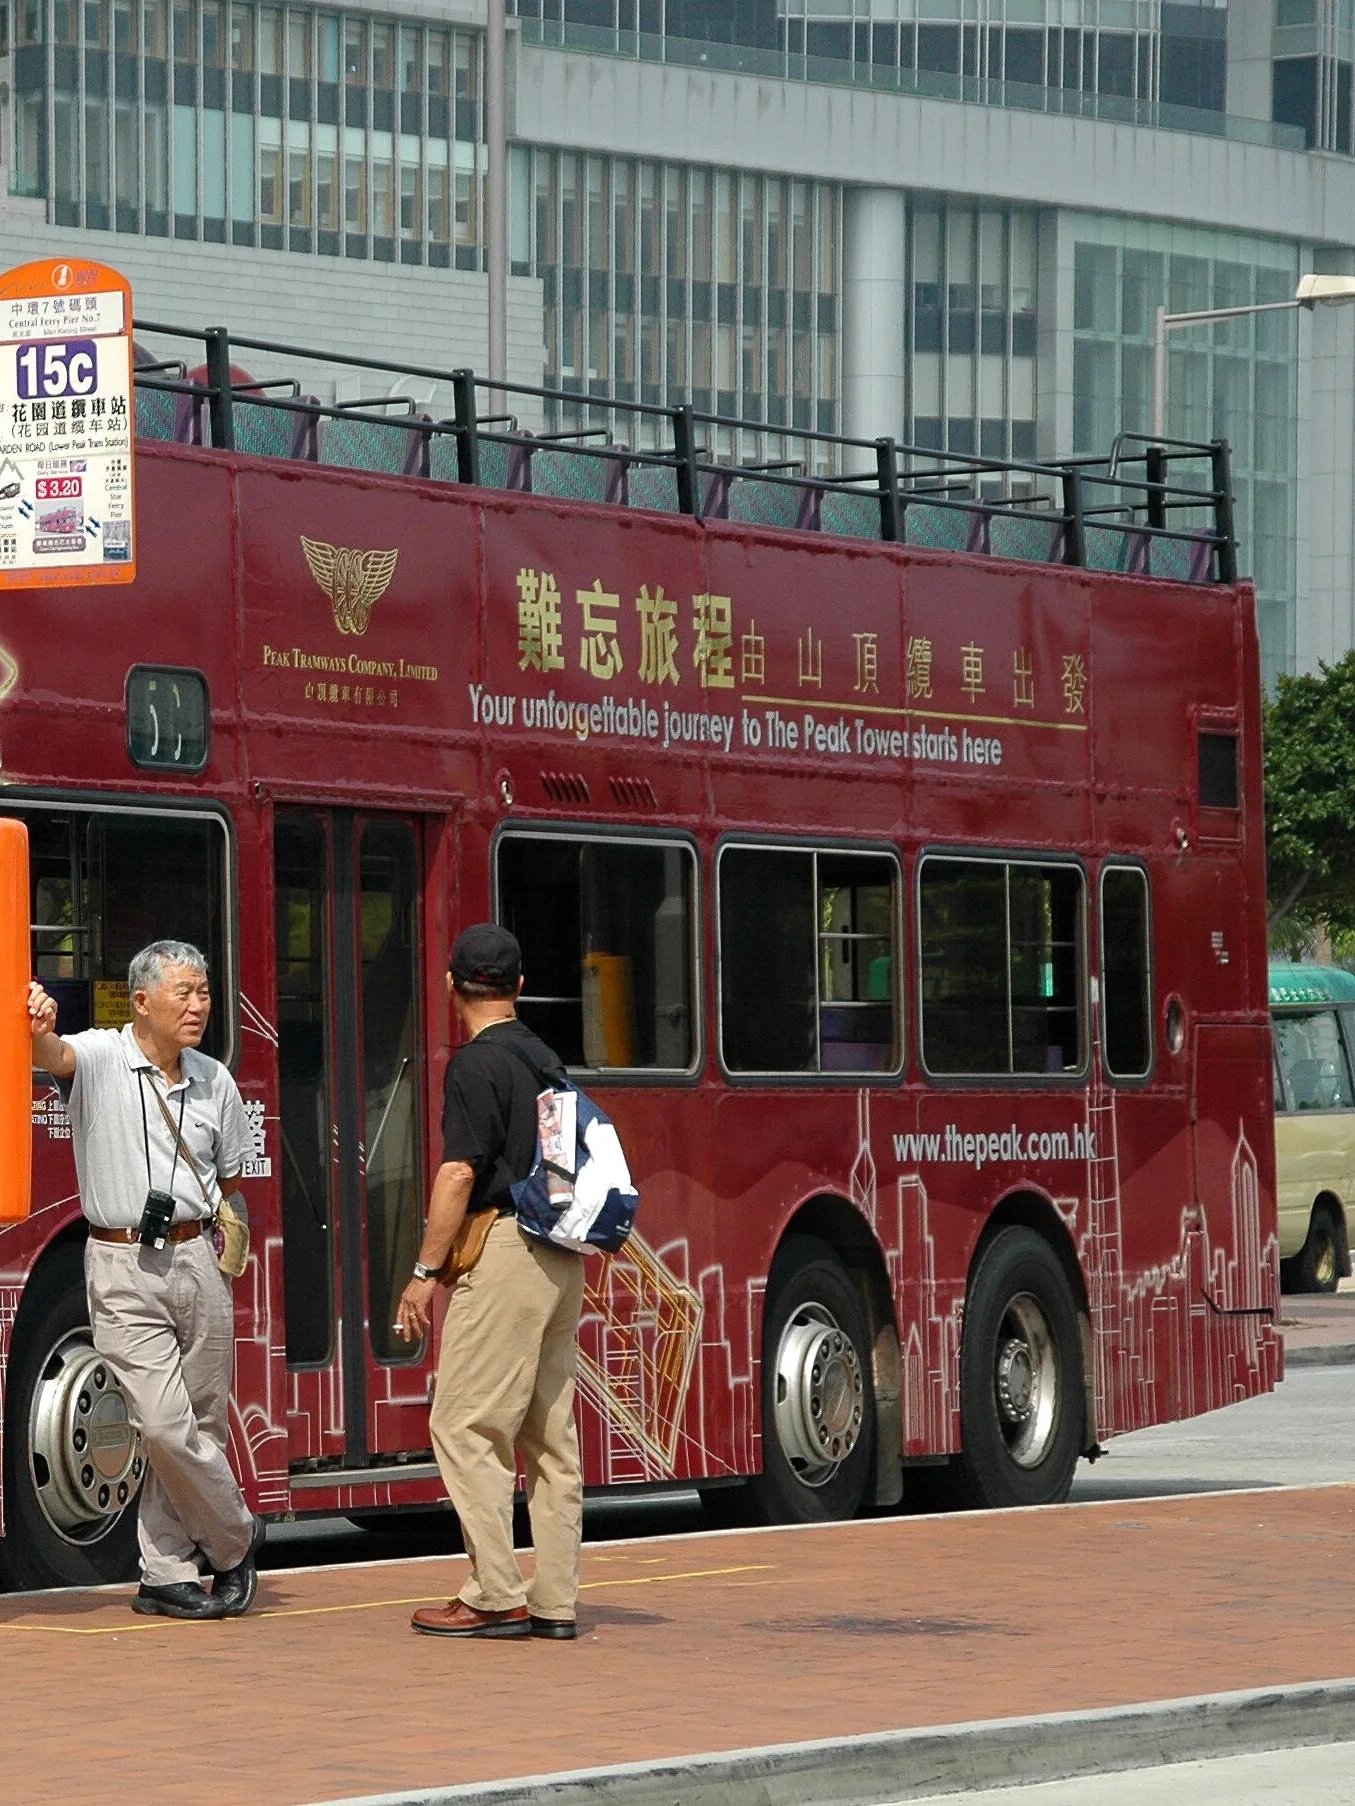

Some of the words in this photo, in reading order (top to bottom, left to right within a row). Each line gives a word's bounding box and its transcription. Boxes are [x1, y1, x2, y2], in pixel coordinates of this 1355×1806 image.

[11, 297, 98, 316] 中環7號碼頭
[9, 318, 38, 328] Central
[40, 317, 60, 327] Ferry
[63, 316, 79, 325] Pier
[25, 442, 45, 452] ROAD
[516, 568, 735, 689] 難忘旅程
[741, 618, 1088, 714] 由山頂纜車出發
[468, 683, 516, 726] Your
[522, 690, 659, 742] unforgettable
[662, 700, 734, 752] journey
[742, 709, 762, 747] to
[766, 711, 798, 750] The
[804, 714, 852, 754] Peak
[854, 719, 909, 758] Tower
[913, 724, 957, 762] starts
[962, 728, 1002, 765] here
[892, 1123, 1097, 1171] www.thepeak.com.hk
[245, 1160, 266, 1175] EXIT
